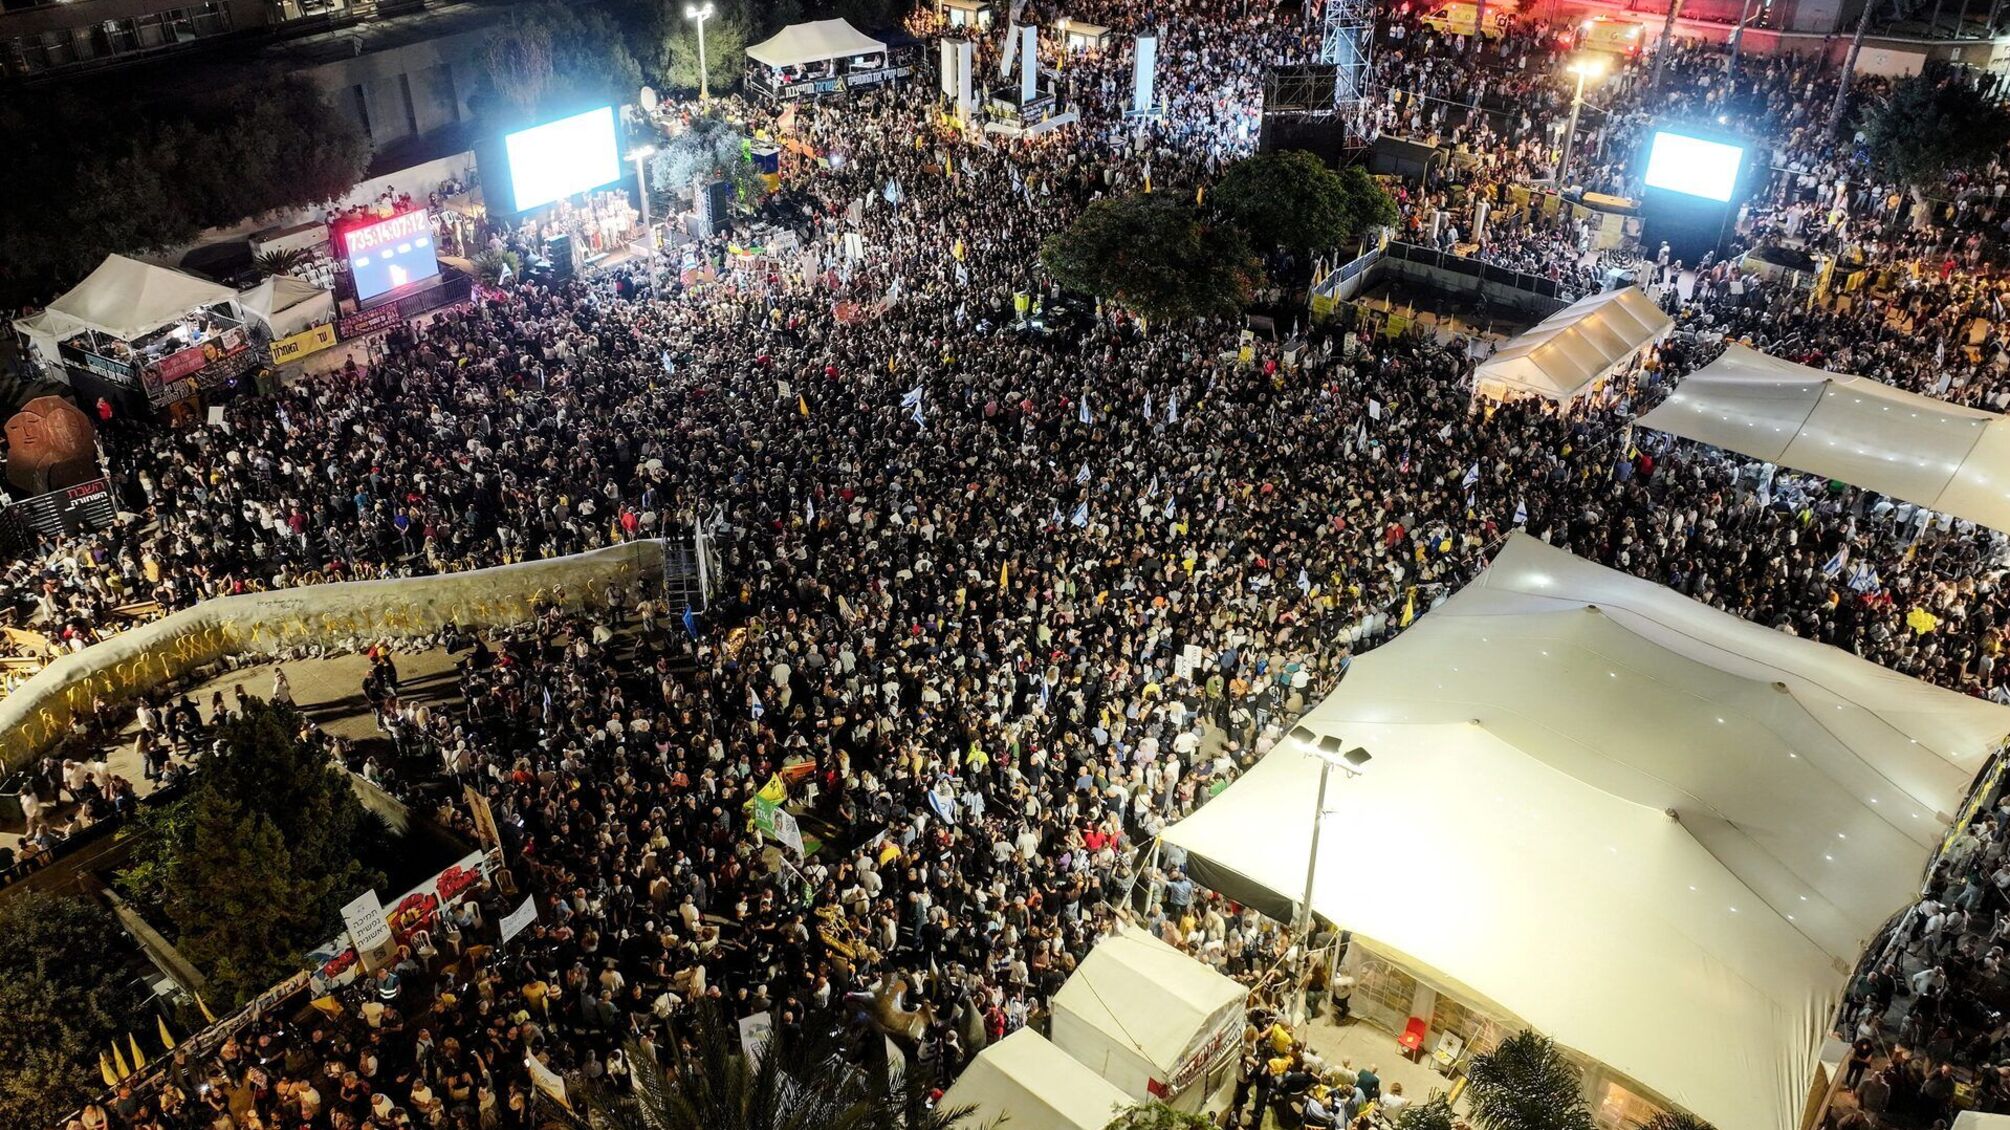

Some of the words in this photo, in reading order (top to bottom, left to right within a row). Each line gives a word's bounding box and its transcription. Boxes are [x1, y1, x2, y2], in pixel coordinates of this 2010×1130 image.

[349, 212, 426, 252] 735:14:07:12
[317, 331, 328, 343] עד
[273, 341, 299, 360] האחרון
[67, 481, 105, 499] השבת
[70, 491, 108, 507] השחורה
[353, 910, 377, 928] תמיכה
[357, 918, 381, 937] נפשית
[357, 924, 387, 947] ראשונית
